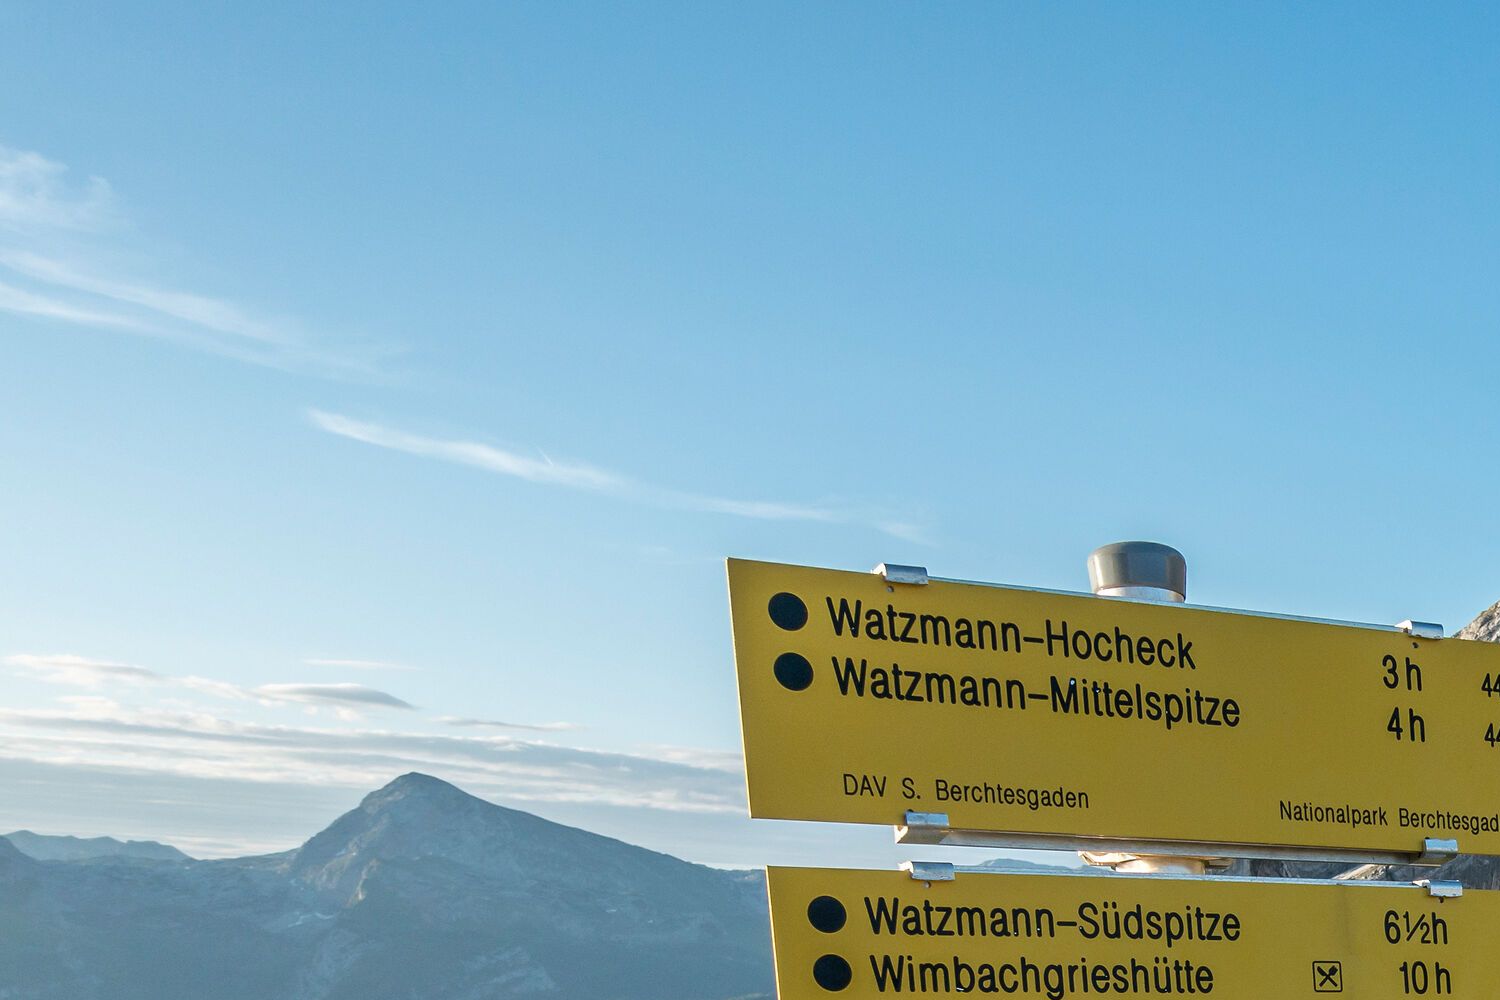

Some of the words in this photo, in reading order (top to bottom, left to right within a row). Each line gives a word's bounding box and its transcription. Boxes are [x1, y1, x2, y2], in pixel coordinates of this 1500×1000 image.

[826, 596, 1196, 669] Watzmann-Hocheck
[1382, 655, 1399, 689] 3
[1406, 657, 1422, 691] h
[832, 655, 1240, 730] Watzmann-Mittelspitze
[1387, 707, 1403, 740] 4
[1409, 708, 1425, 742] h
[843, 774, 886, 797] DAV
[902, 778, 920, 799] S.
[936, 779, 1088, 810] Berchtesgaden
[1280, 800, 1388, 828] Nationalpark
[864, 897, 1240, 948] Watzmann-Südspitze
[870, 955, 1213, 1000] Wimbachgrieshütte
[1399, 961, 1428, 994] 10
[1435, 962, 1451, 994] h
